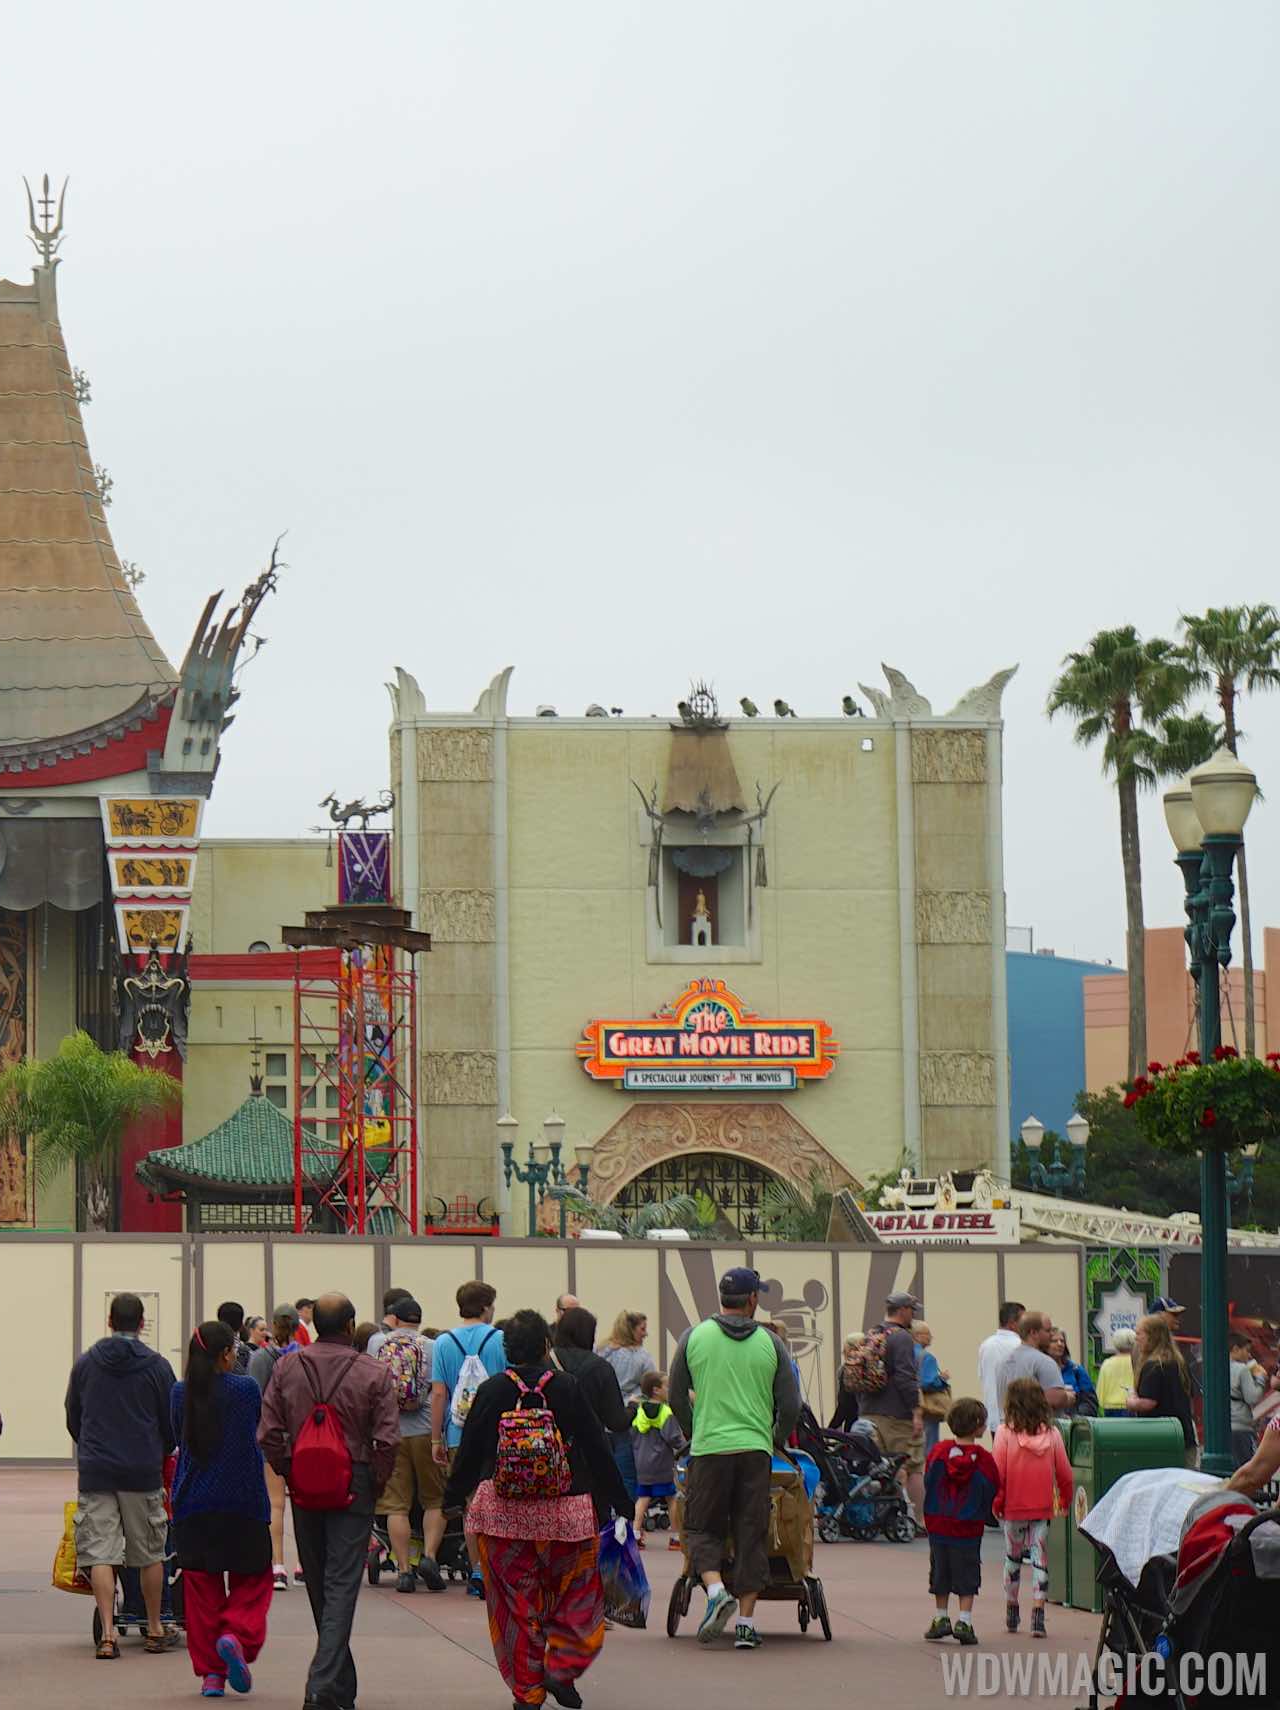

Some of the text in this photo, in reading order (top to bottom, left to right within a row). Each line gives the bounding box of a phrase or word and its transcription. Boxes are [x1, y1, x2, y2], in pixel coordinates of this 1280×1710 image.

[688, 1005, 727, 1033] The
[608, 1031, 810, 1057] GREAT MOVIE RIDE
[633, 1073, 639, 1083] A
[641, 1073, 687, 1083] SPECTACULAR
[689, 1073, 721, 1083] JOURNEY
[740, 1073, 753, 1082] THE
[755, 1073, 782, 1082] MOVIES
[932, 1213, 995, 1229] STEEL
